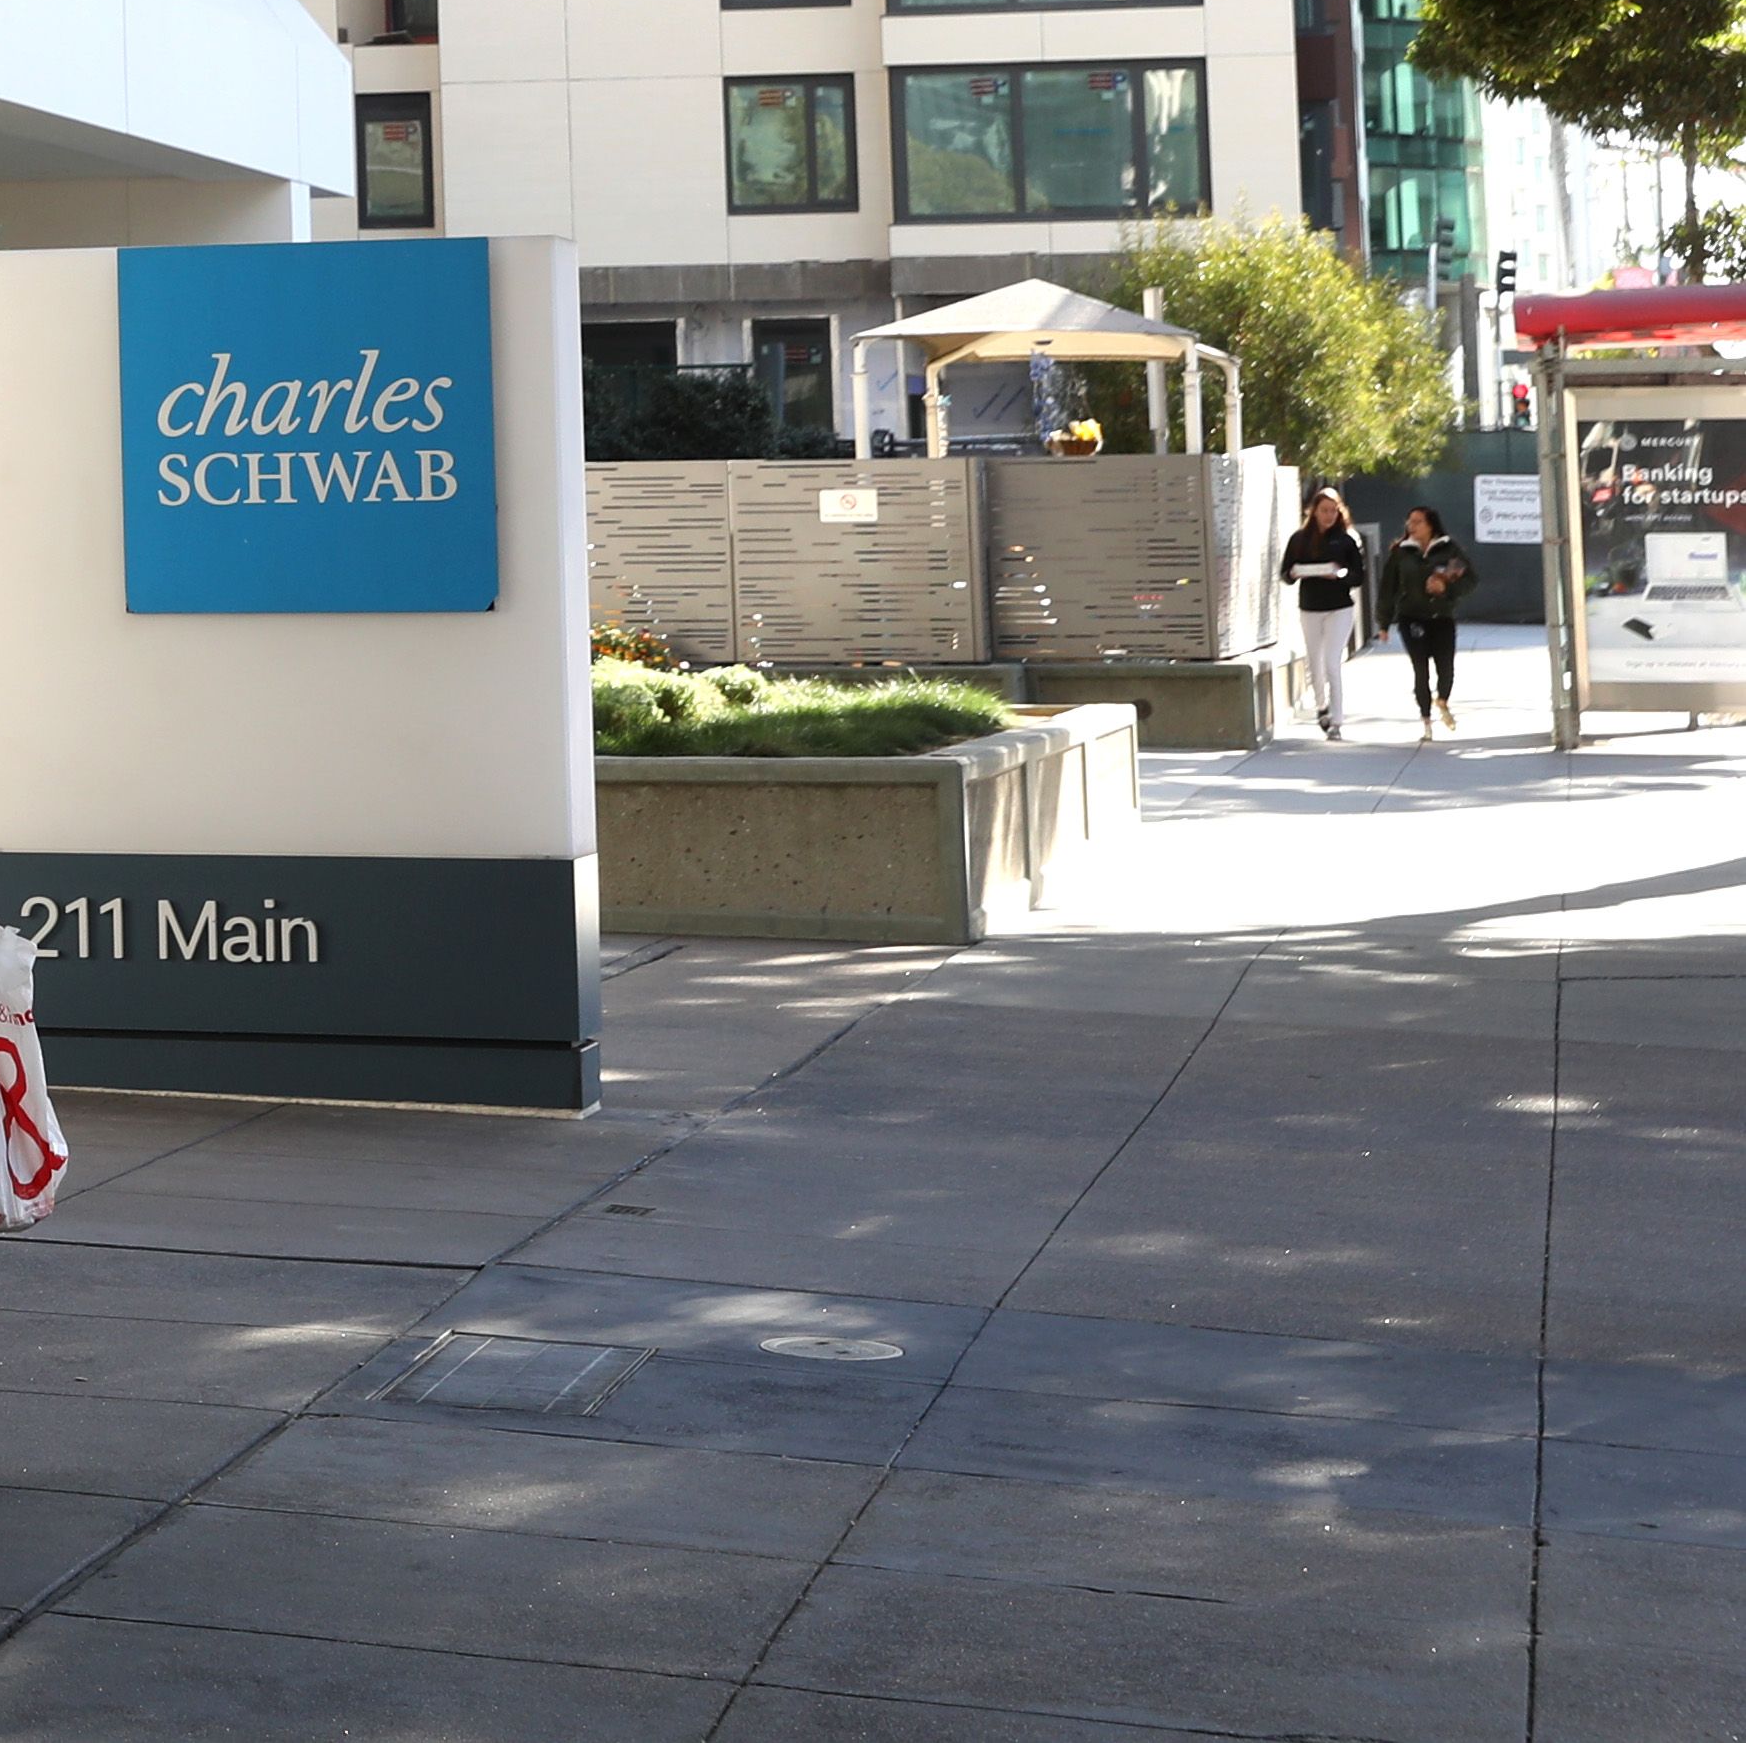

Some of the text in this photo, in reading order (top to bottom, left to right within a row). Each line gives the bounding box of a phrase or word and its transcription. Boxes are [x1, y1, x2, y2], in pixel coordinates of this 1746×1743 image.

[157, 349, 453, 438] charles
[157, 450, 459, 507] SCHWAB
[1622, 462, 1714, 486] Banking
[1622, 486, 1656, 505] for
[20, 896, 320, 963] 211 Main
